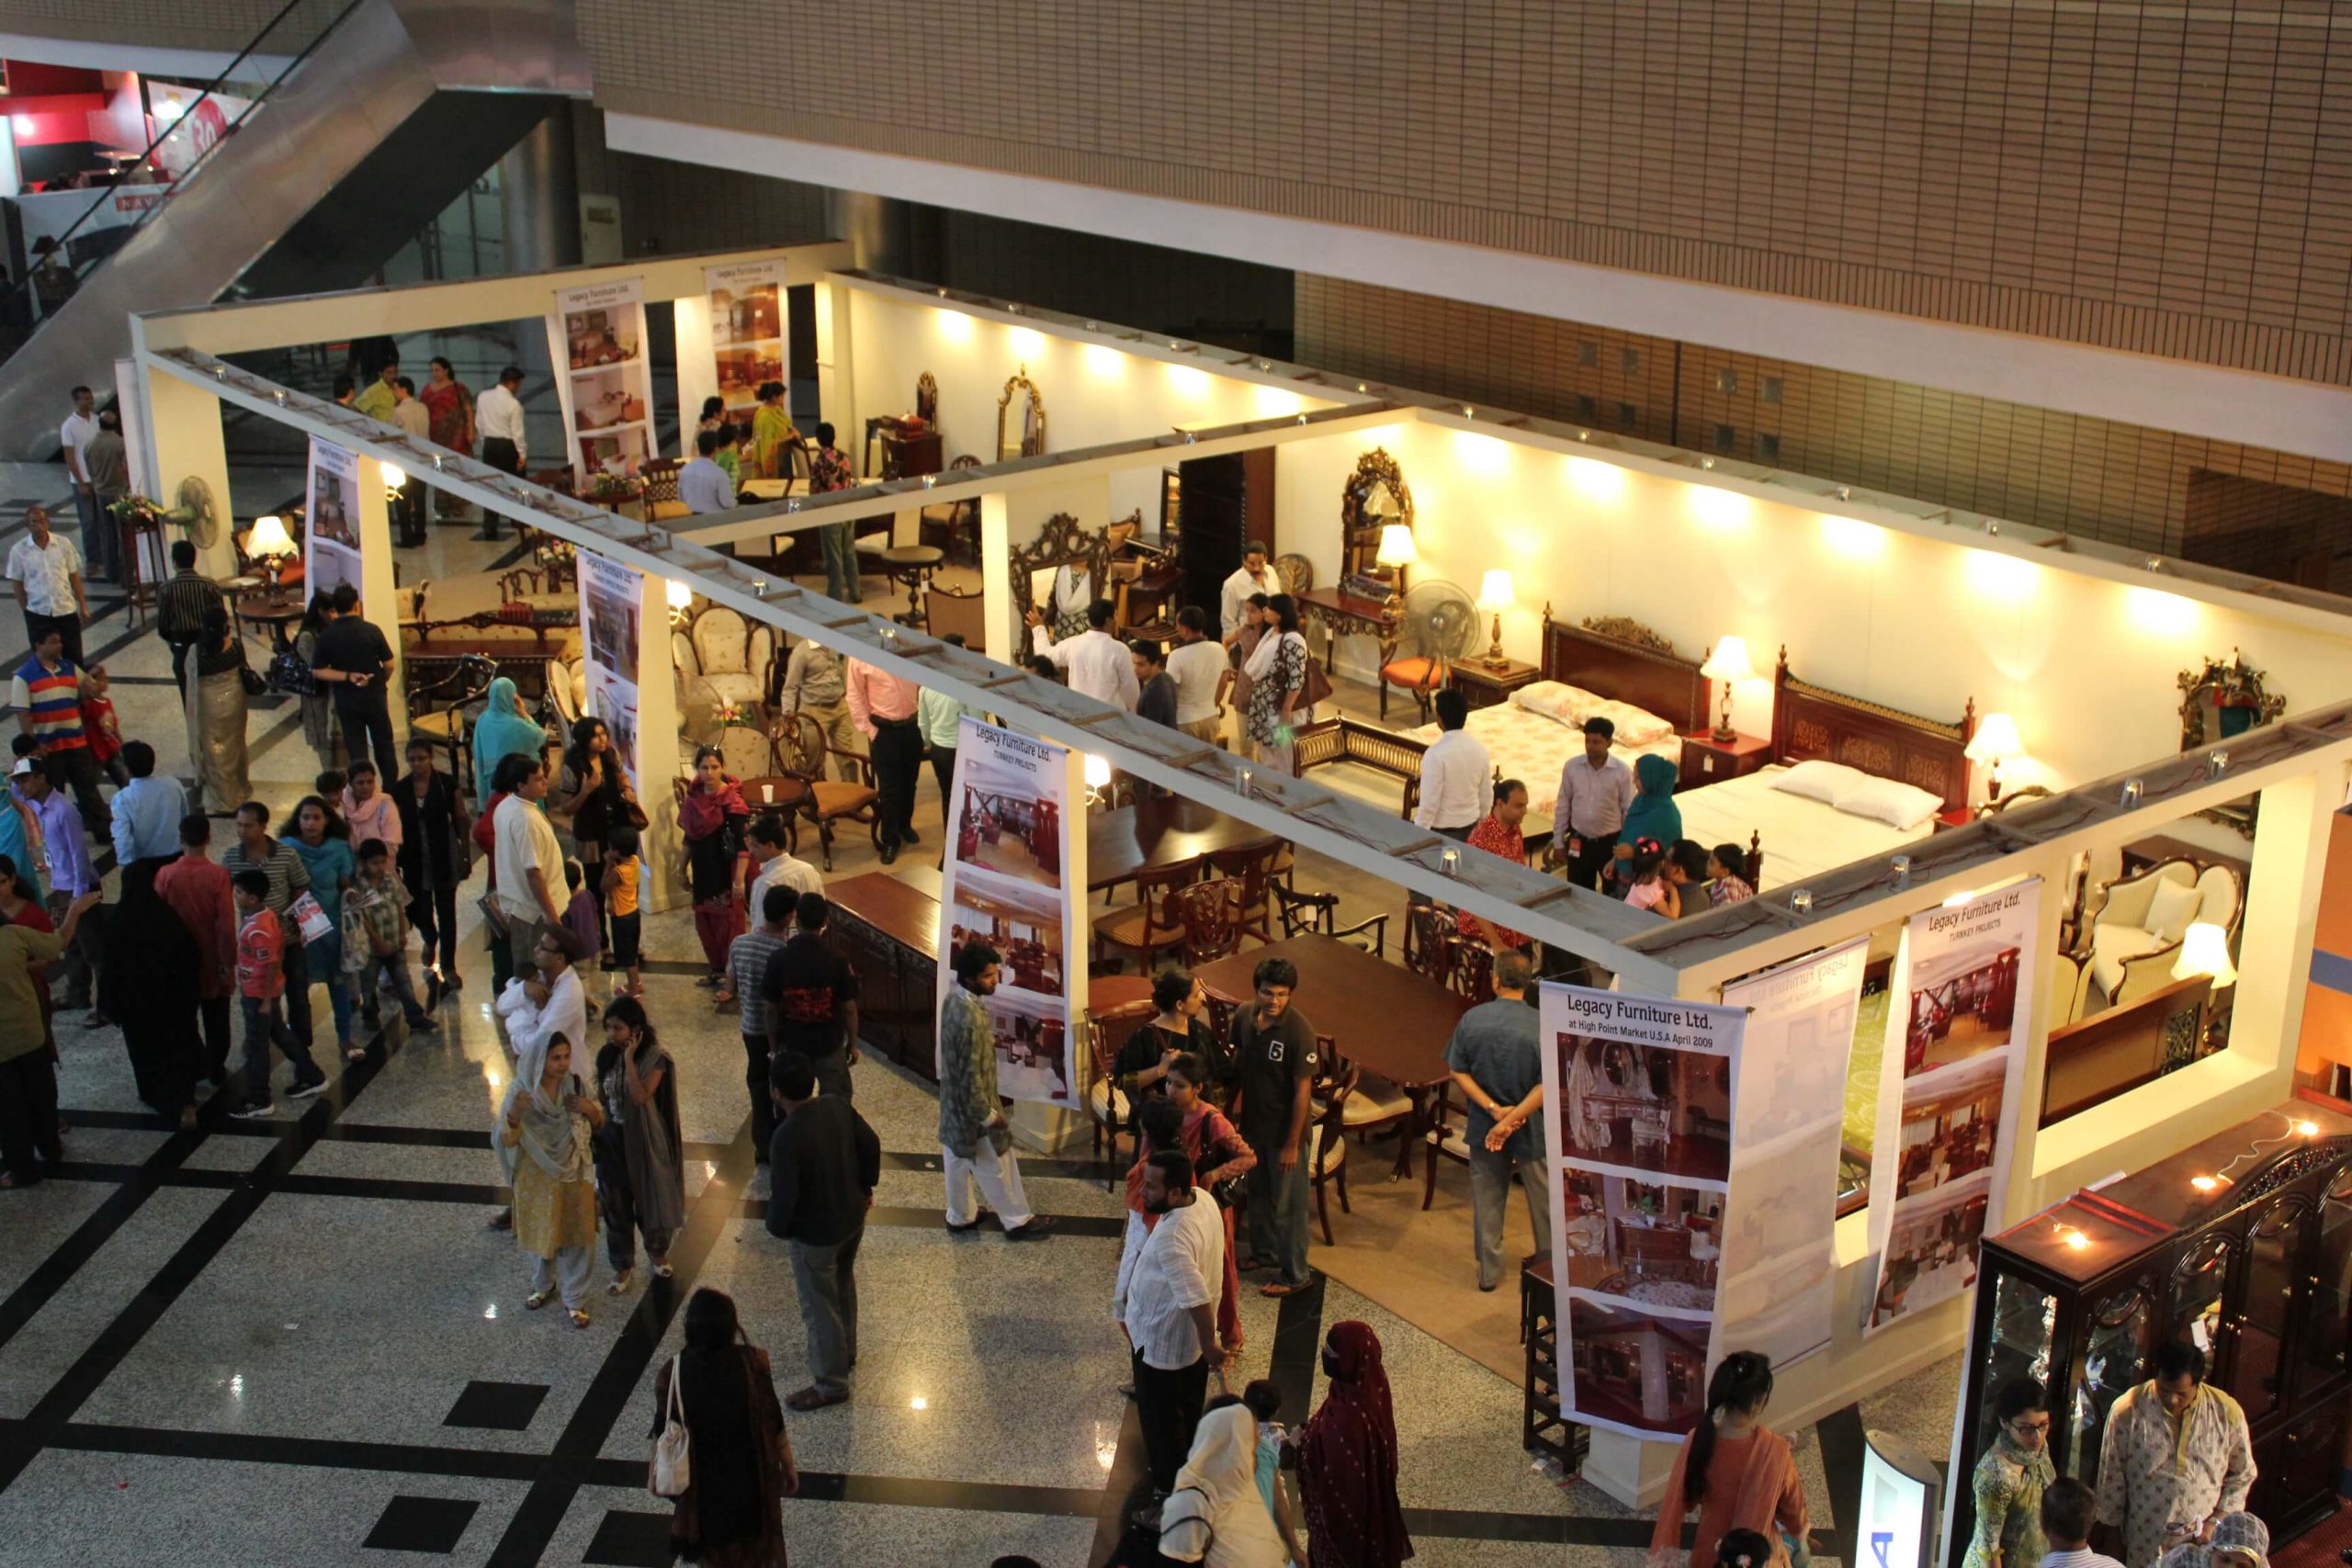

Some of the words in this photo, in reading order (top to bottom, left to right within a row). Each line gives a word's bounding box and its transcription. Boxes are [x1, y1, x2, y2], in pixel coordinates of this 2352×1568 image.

[976, 724, 1001, 747] Legacy
[1001, 734, 1035, 757] Furniture
[1036, 746, 1052, 762] Ltd.
[1014, 757, 1037, 773] PROJECTS
[1928, 912, 1961, 932] Legacy
[1961, 898, 2002, 923] Furniture
[2003, 891, 2020, 909] Ltd.
[1974, 918, 2002, 935] PROJECTS
[1567, 994, 1612, 1020] Legacy
[1617, 1000, 1681, 1026] Furniture
[1686, 1011, 1713, 1030] Ltd.
[1568, 1020, 1577, 1029] at
[1578, 1021, 1596, 1033] High
[1598, 1022, 1618, 1035] Point
[1621, 1025, 1648, 1040] Market
[1650, 1030, 1670, 1043] U.S.A
[1672, 1033, 1691, 1046] April
[1693, 1035, 1713, 1048] 2009
